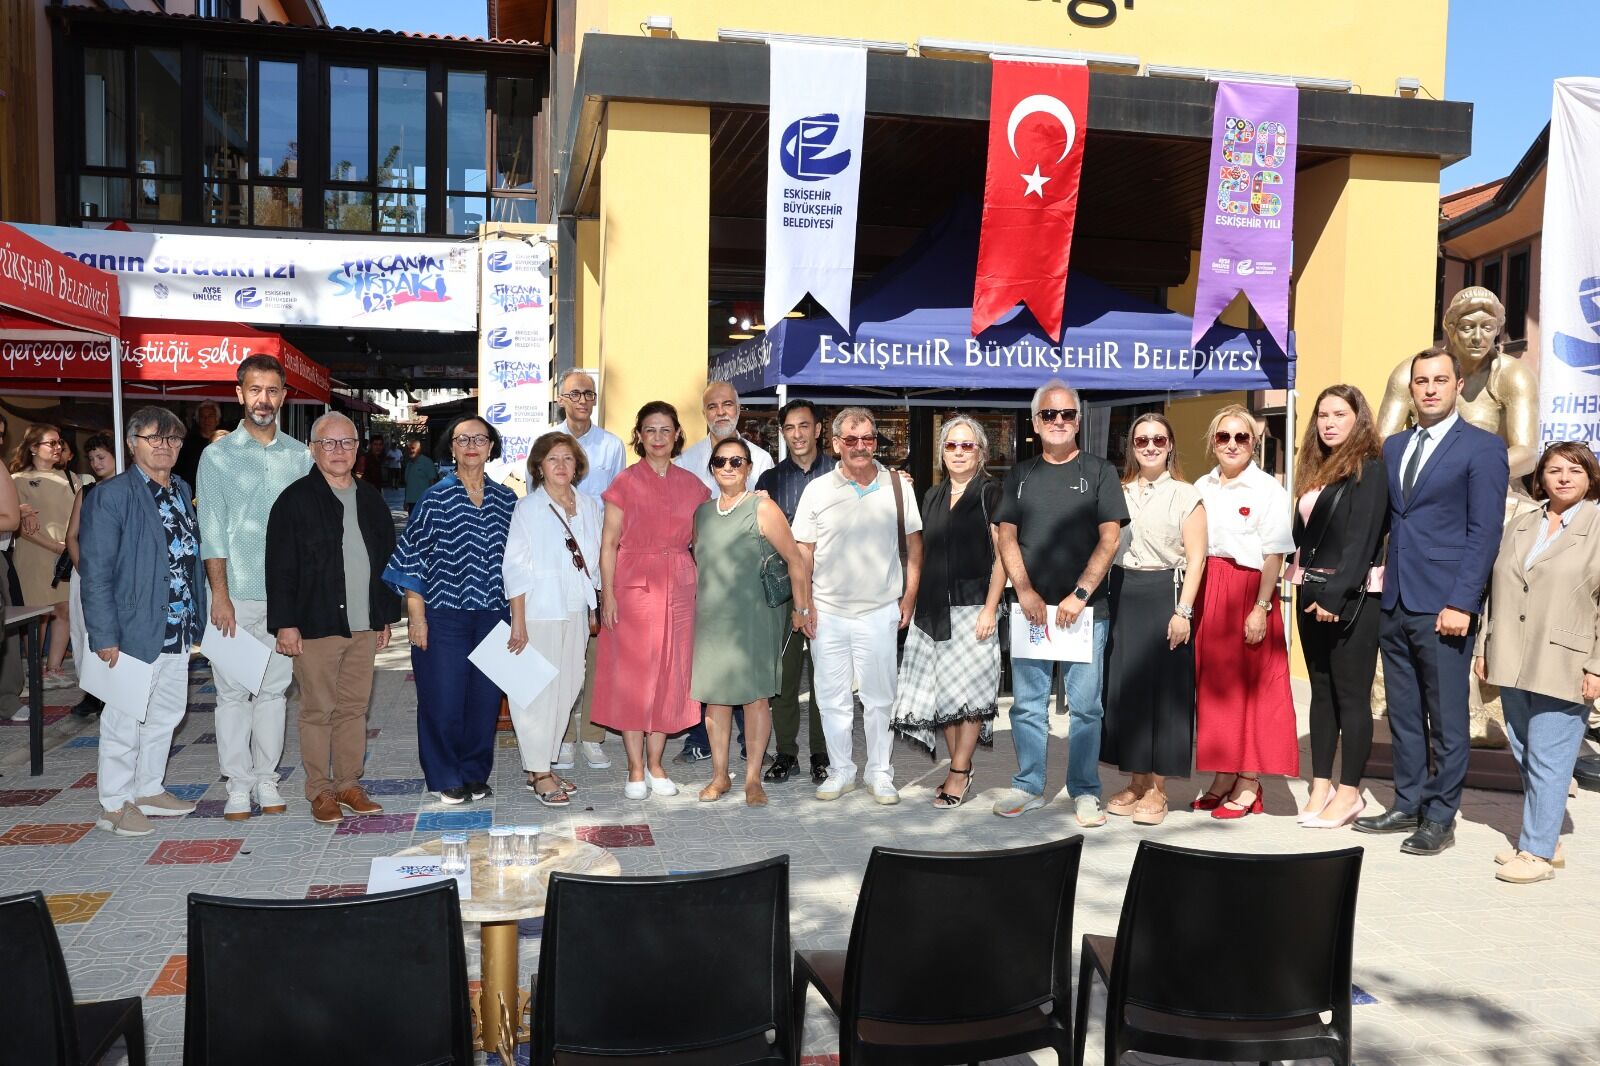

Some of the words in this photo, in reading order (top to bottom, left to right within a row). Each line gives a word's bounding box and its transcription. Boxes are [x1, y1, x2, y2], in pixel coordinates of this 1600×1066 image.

[784, 187, 831, 201] ESKİŞEHİR
[783, 202, 842, 215] BÜYÜKŞEHİR
[783, 216, 834, 229] BELEDİYESİ
[1215, 214, 1262, 229] ESKİŞEHİR
[1264, 218, 1281, 229] YILI
[192, 291, 222, 302] ÜNLÜCE
[202, 286, 222, 295] AYŞE
[81, 339, 194, 373] döüştüğü
[819, 334, 954, 370] ESKİŞEHİR
[965, 338, 1122, 373] BÜYÜKŞEHİR
[1133, 339, 1262, 371] BELEDİYESİ
